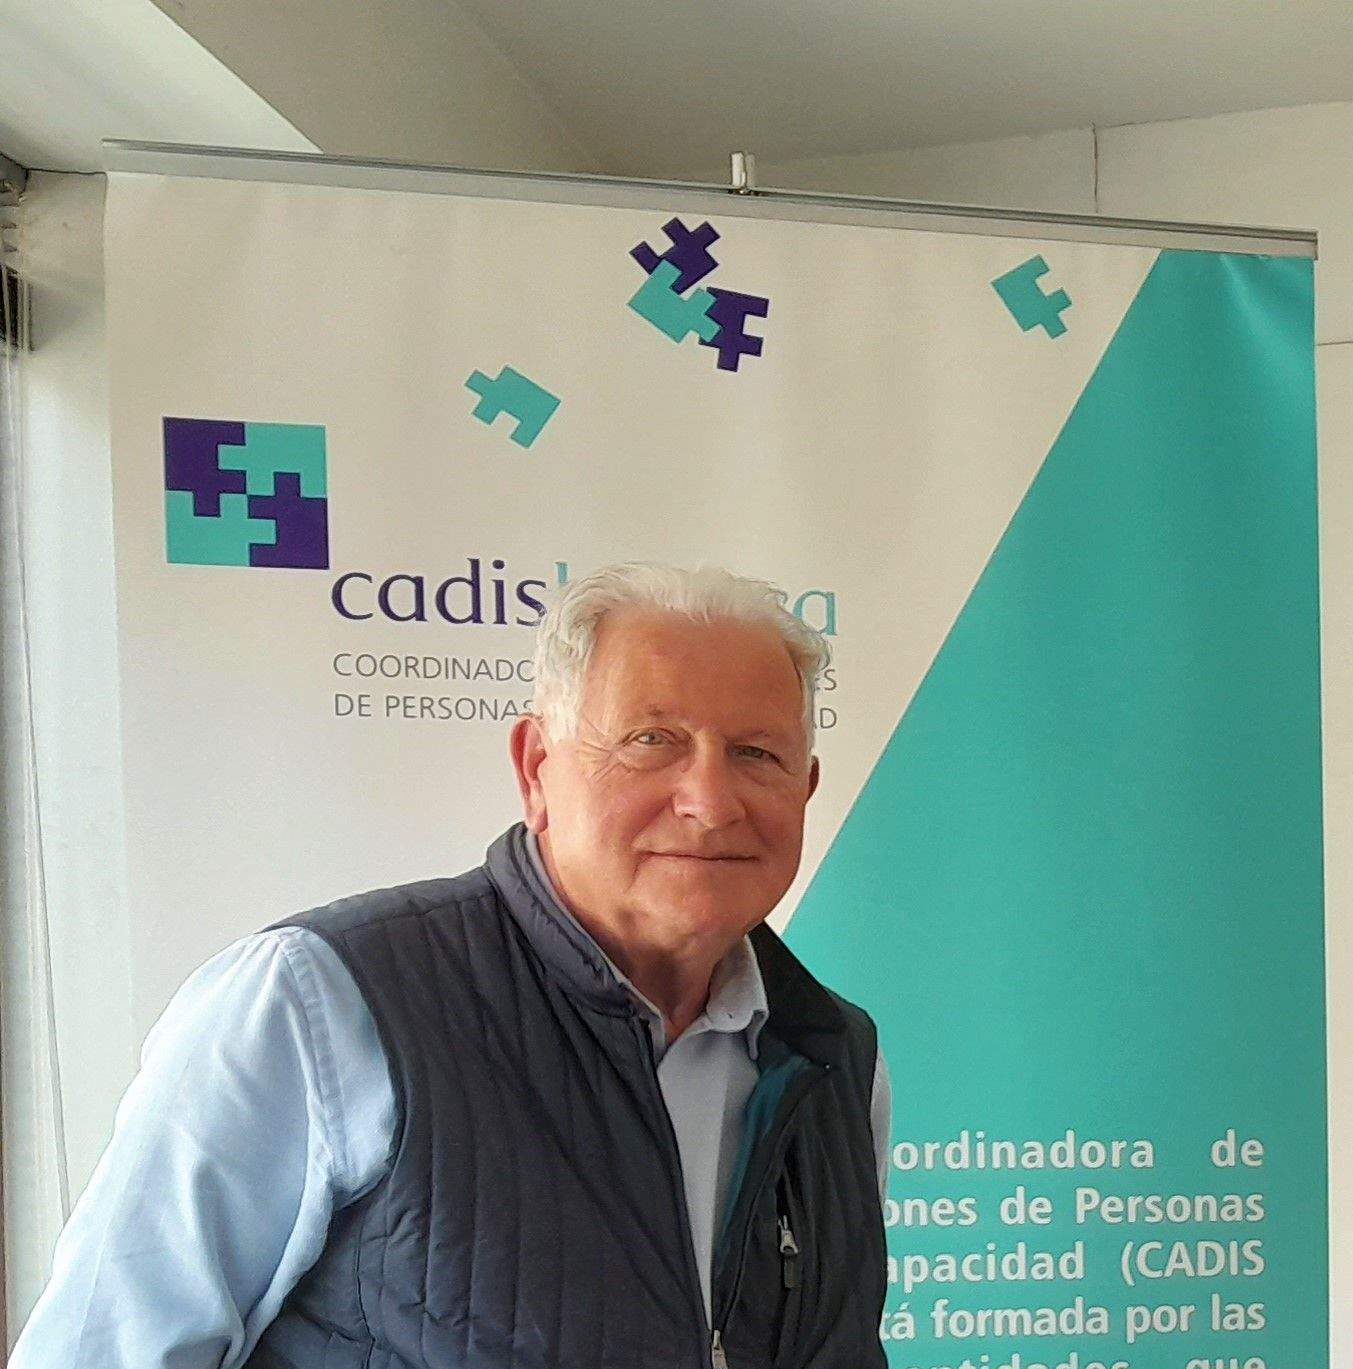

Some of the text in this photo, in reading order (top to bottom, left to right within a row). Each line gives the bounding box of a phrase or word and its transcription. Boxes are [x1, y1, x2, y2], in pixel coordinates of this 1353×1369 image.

[332, 652, 534, 683] COORDINADO
[334, 694, 372, 718] DE
[893, 1129, 1264, 1171] ordinadora de
[1000, 1186, 1053, 1226] de
[1076, 1187, 1265, 1224] Personas
[1121, 1240, 1265, 1284] (CADIS
[932, 1297, 1108, 1338] formada
[1126, 1304, 1196, 1343] por
[1211, 1294, 1266, 1332] las
